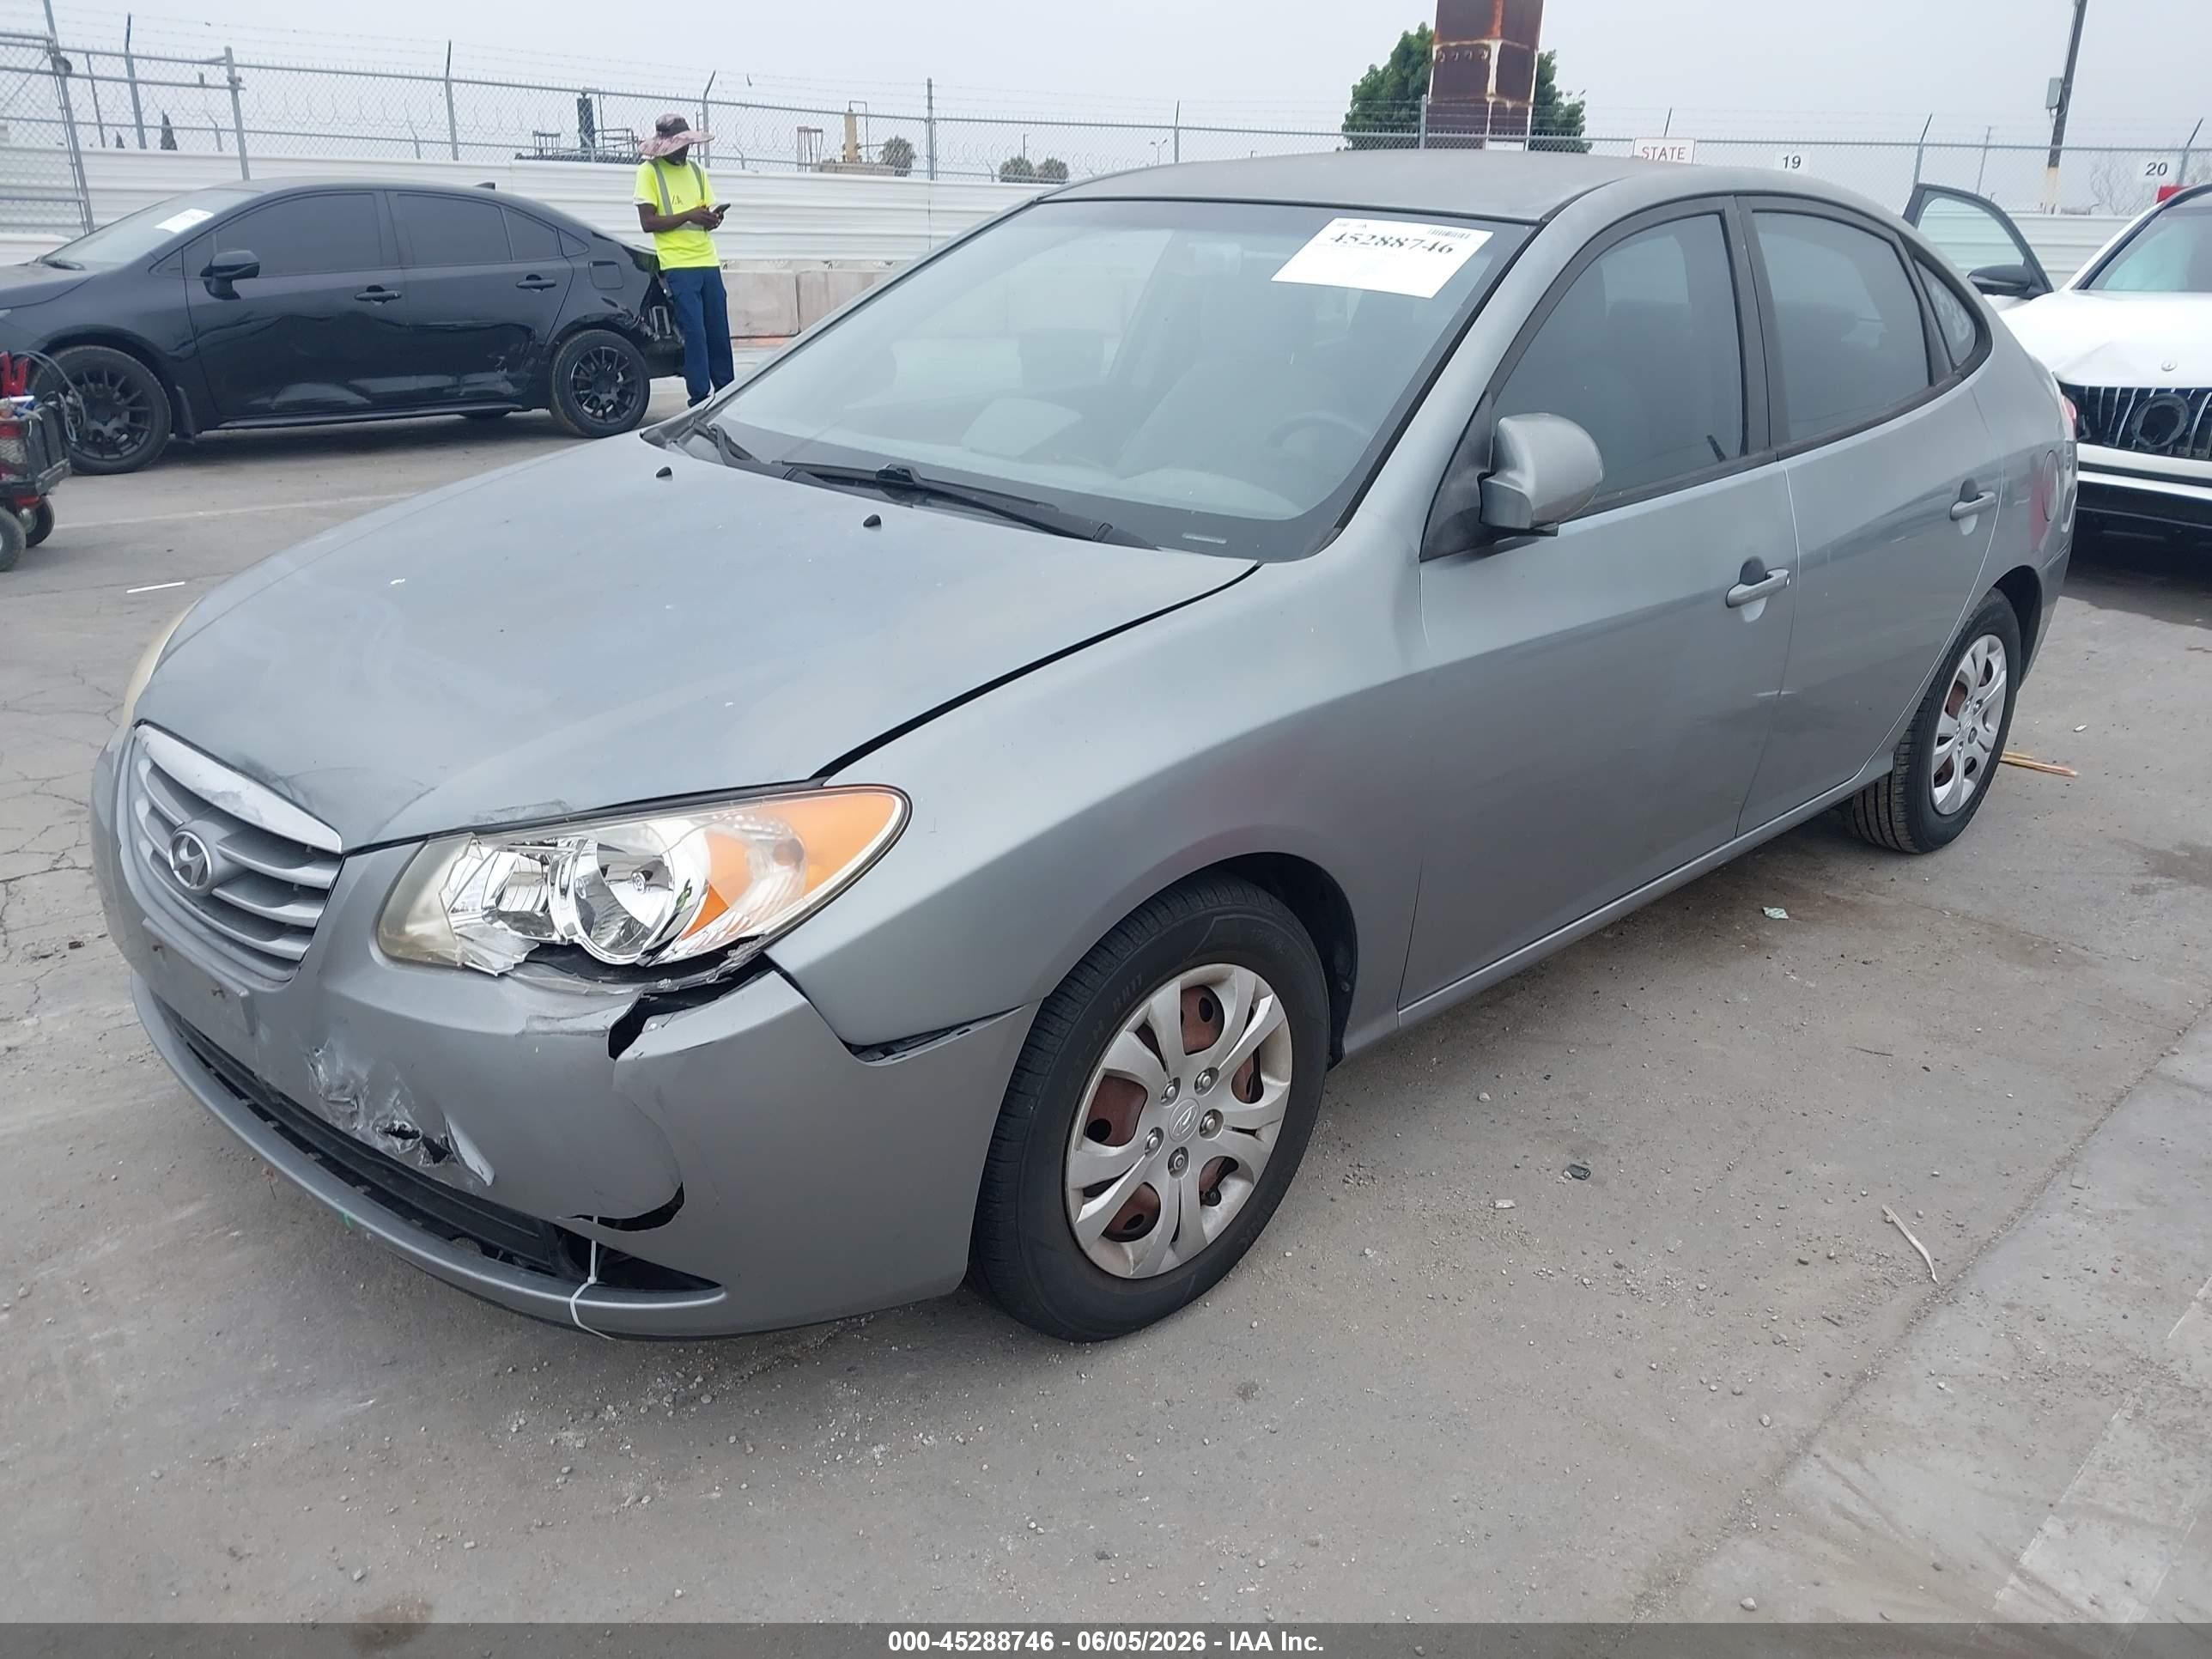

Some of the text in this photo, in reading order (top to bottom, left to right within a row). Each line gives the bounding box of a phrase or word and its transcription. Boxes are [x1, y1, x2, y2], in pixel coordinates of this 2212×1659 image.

[1642, 146, 1686, 161] STATE
[1783, 155, 1802, 169] 19
[2145, 161, 2168, 176] 20
[1329, 231, 1455, 254] 45288746
